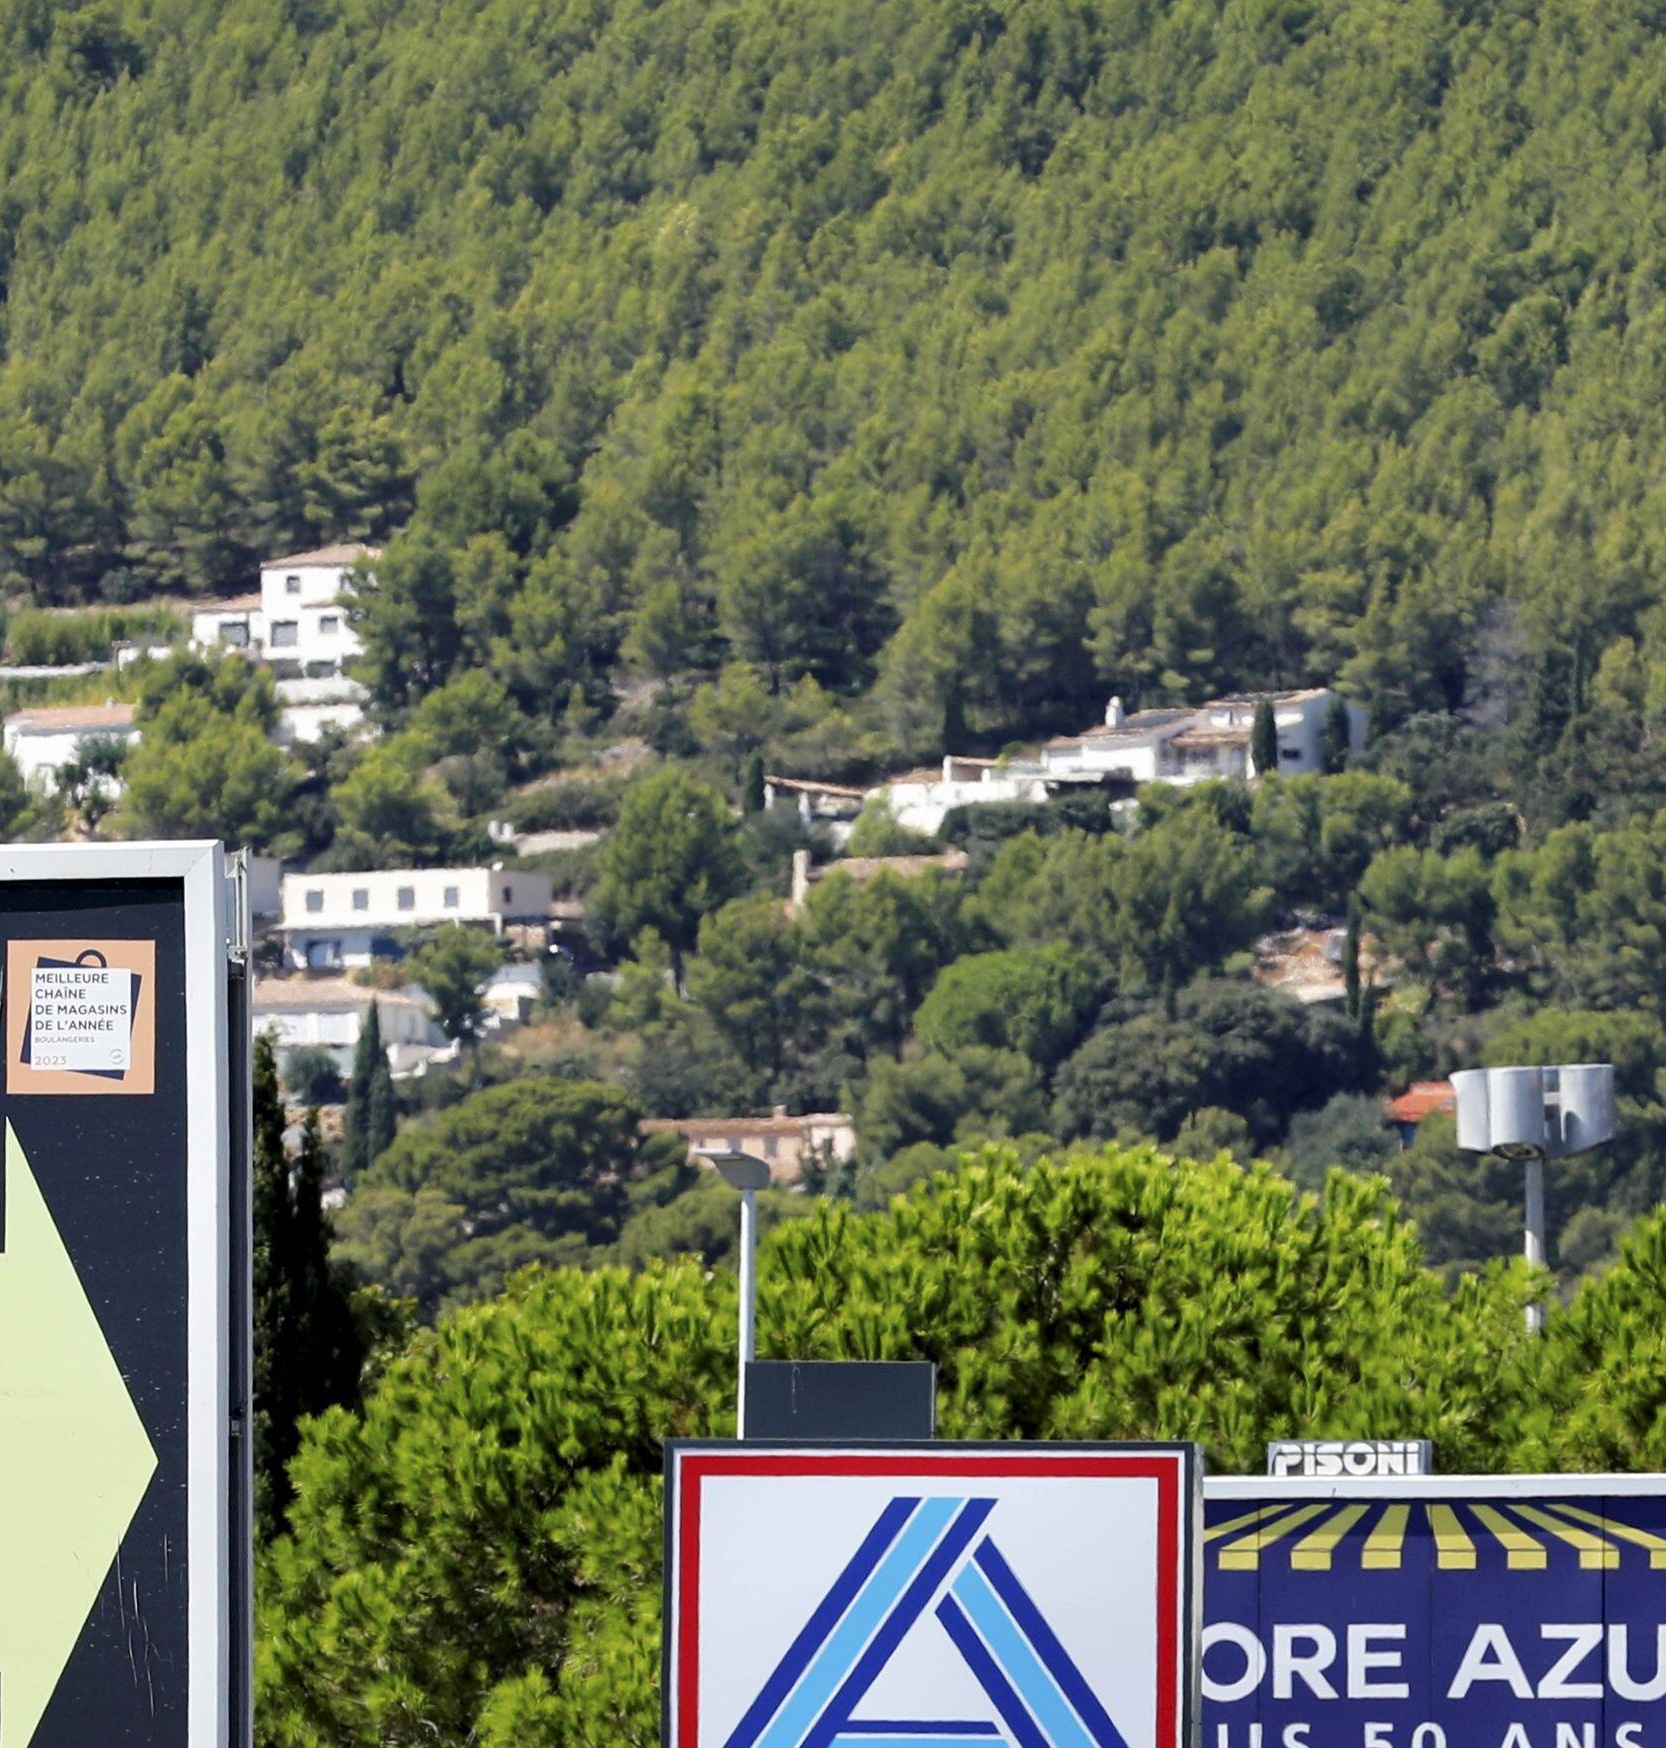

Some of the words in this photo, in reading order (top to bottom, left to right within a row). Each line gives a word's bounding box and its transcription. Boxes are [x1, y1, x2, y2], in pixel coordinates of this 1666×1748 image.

[35, 973, 109, 984] MEILLEURE
[35, 986, 86, 1000] CHAÎNE
[35, 1004, 53, 1016] DE
[57, 1004, 127, 1016] MAGASINS
[35, 1020, 53, 1031] DE
[57, 1017, 114, 1031] L'ANNÉE
[34, 1036, 95, 1044] BOULANGERIES
[34, 1055, 67, 1066] 2023
[1275, 1443, 1420, 1476] PISONI
[1201, 1622, 1410, 1703] ORE
